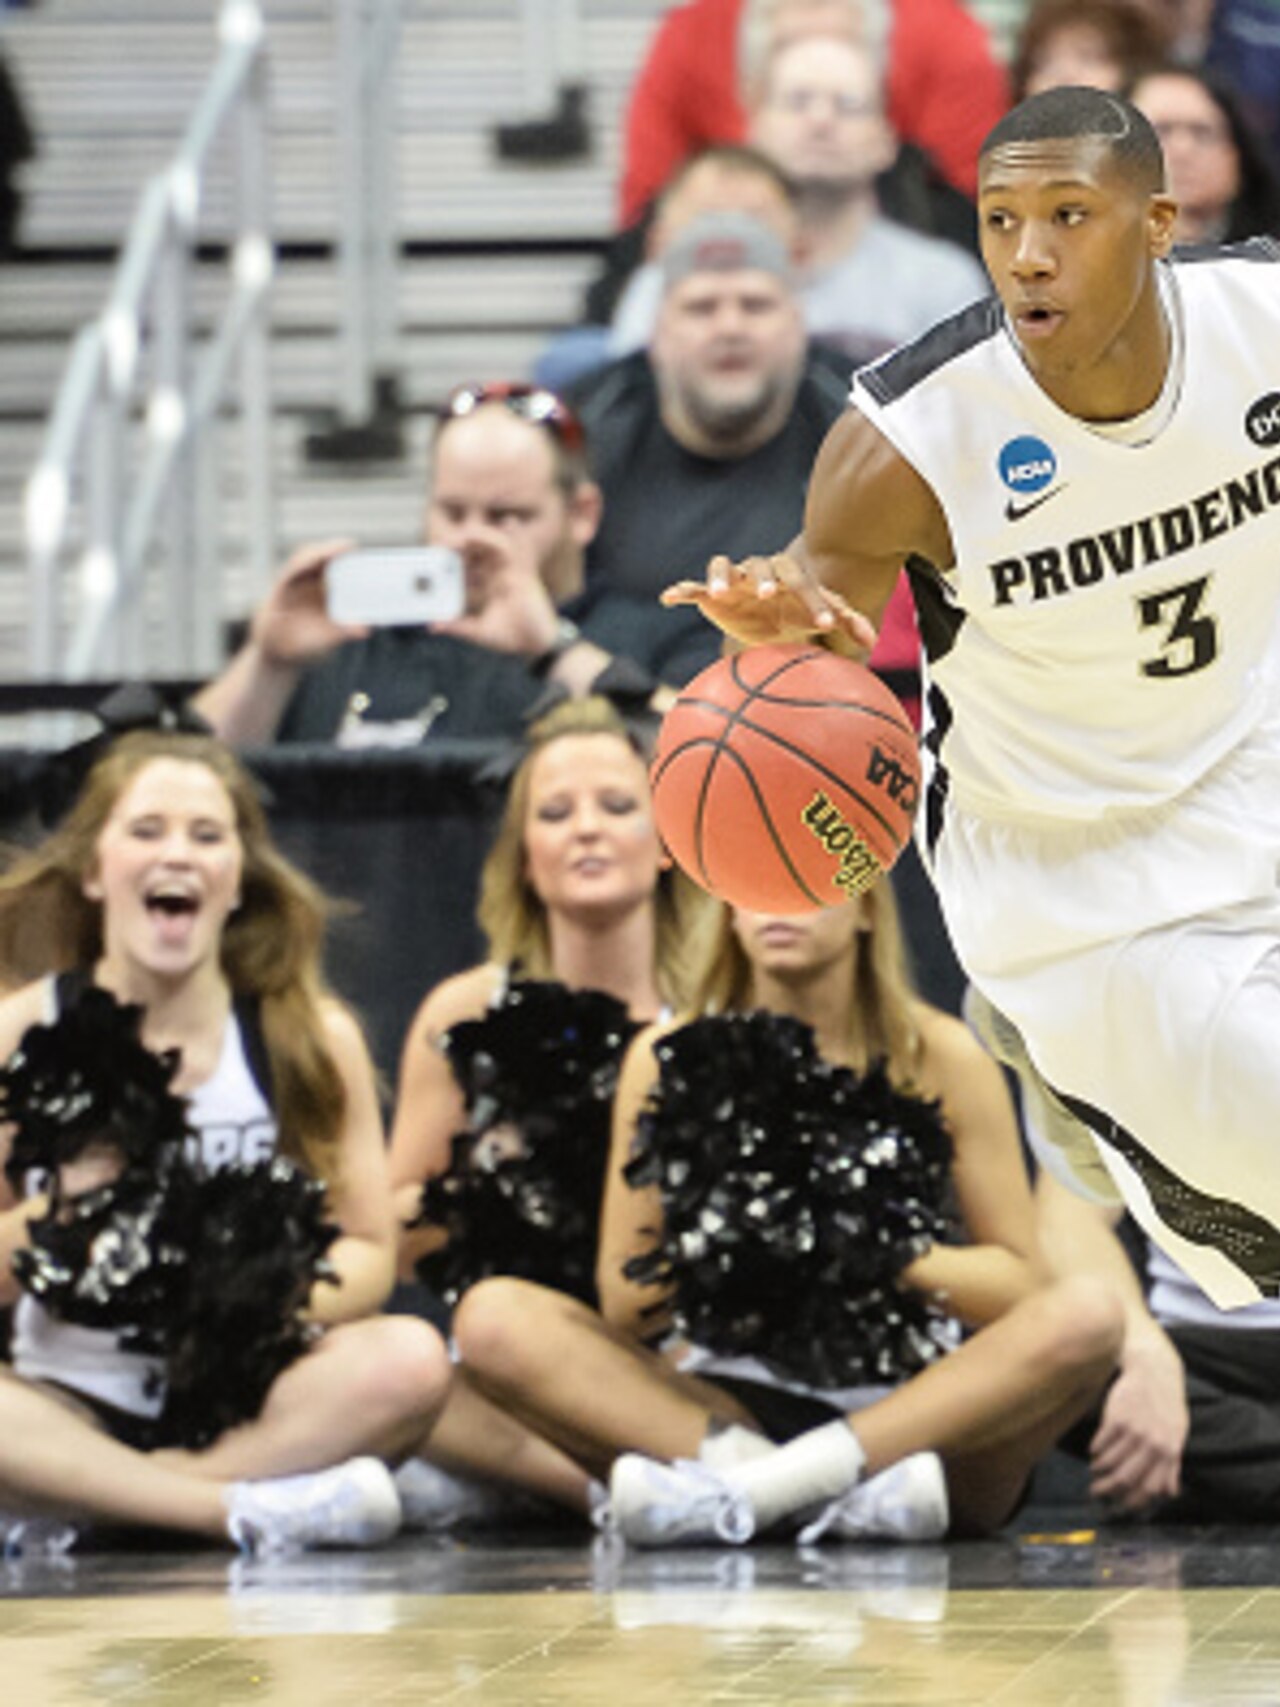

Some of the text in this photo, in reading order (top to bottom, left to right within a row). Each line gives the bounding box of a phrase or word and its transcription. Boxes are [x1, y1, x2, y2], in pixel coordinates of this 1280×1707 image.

[1007, 459, 1053, 484] NCAA
[1134, 571, 1218, 678] 3
[865, 745, 918, 814] CAA
